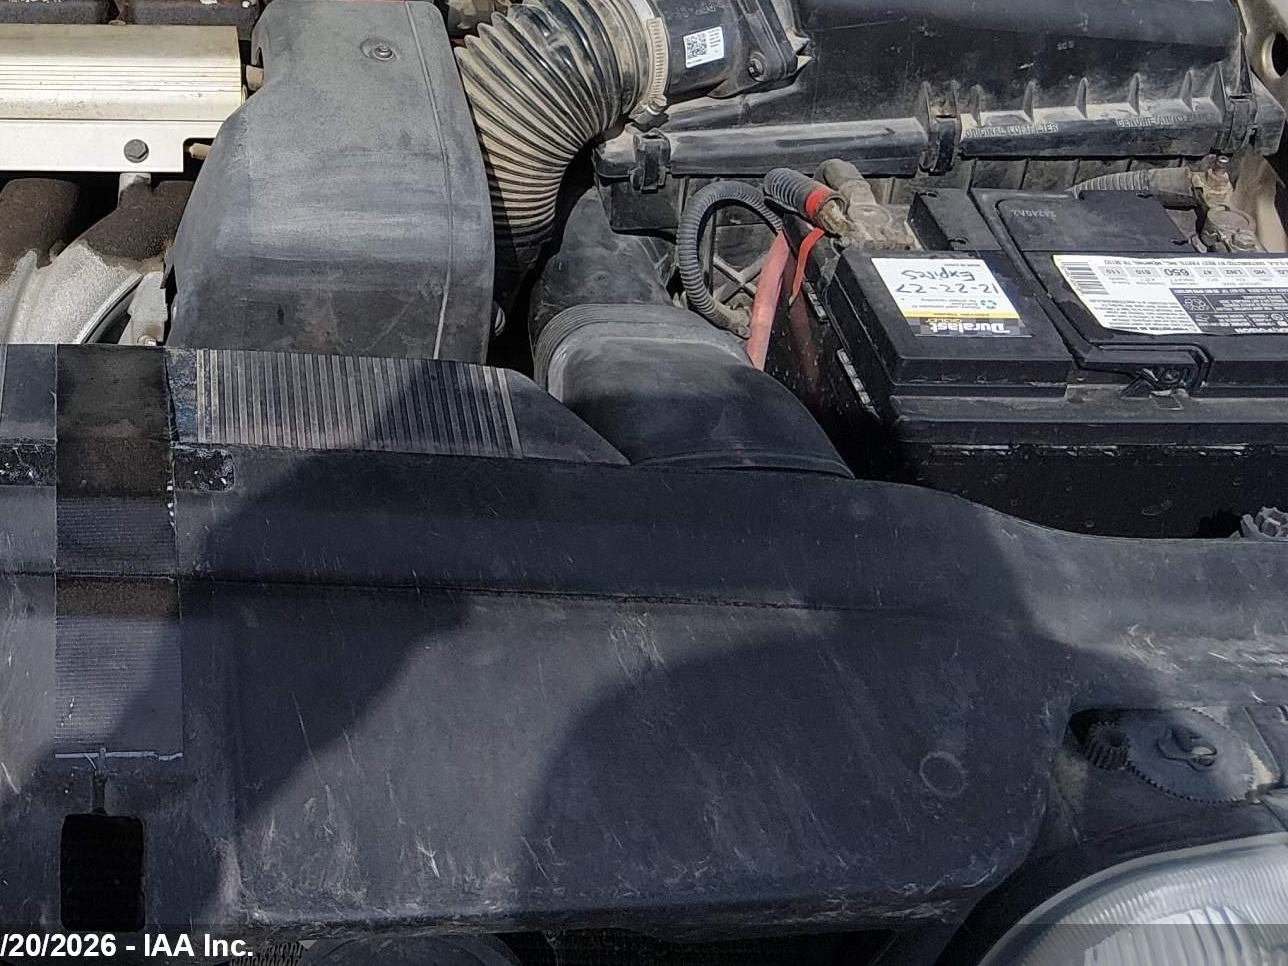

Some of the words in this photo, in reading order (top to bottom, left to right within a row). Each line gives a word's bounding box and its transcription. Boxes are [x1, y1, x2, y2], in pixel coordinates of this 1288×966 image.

[901, 266, 976, 282] Expires
[1163, 268, 1190, 277] 650
[895, 283, 1000, 295] 12-22-27
[929, 322, 1011, 334] Duralast
